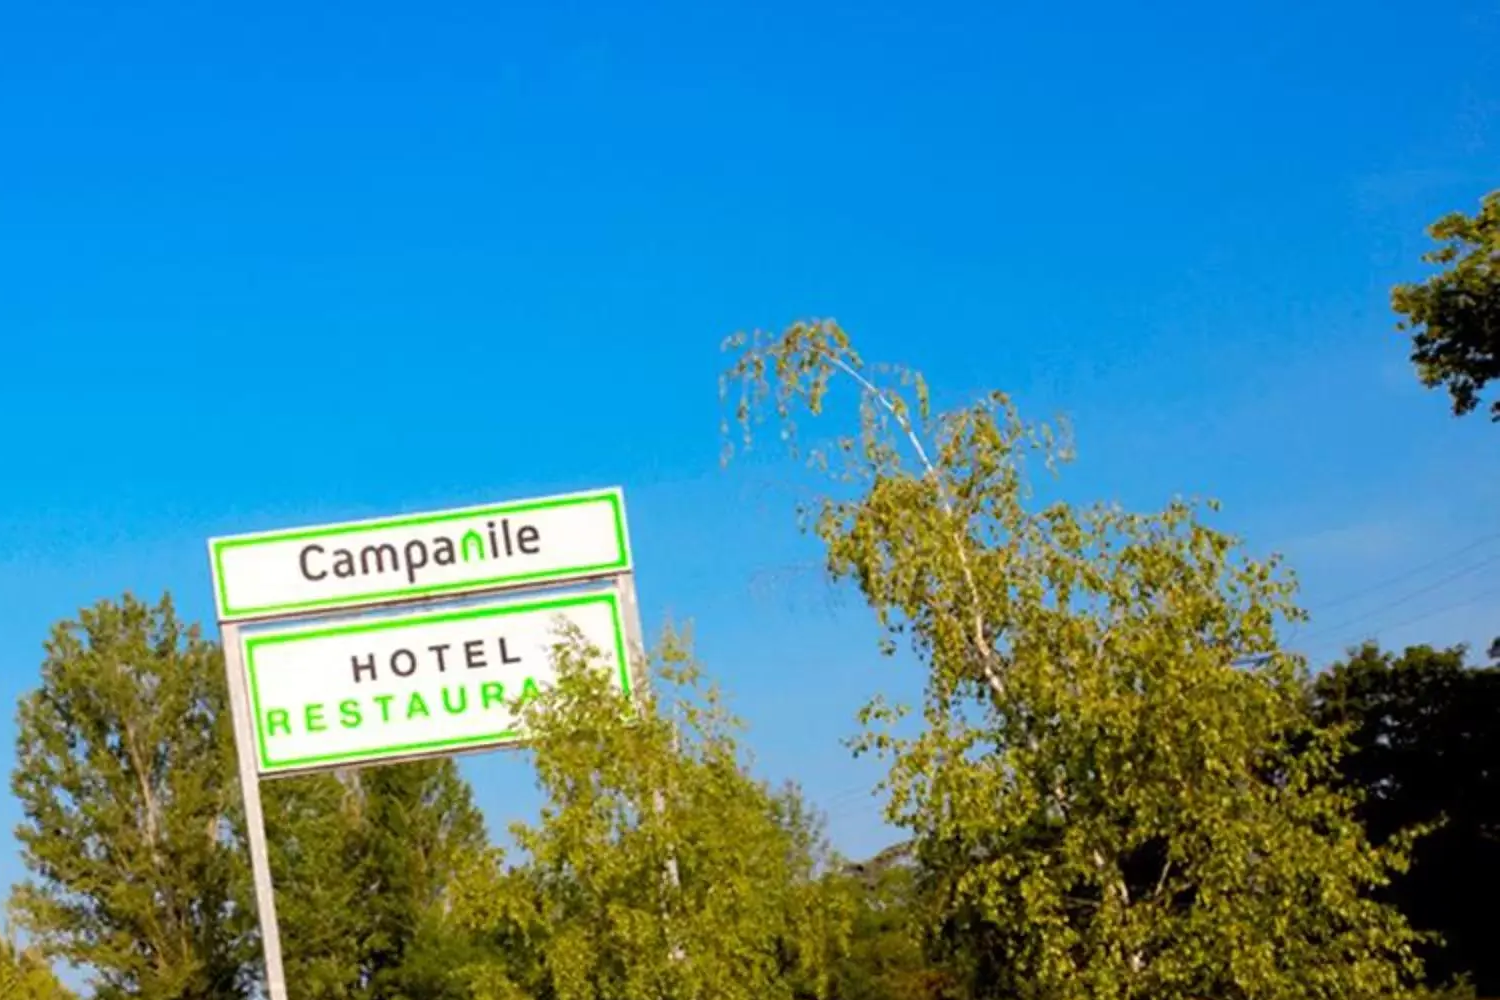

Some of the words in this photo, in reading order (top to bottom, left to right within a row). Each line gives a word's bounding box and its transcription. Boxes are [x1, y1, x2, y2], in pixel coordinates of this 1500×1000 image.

[299, 518, 541, 585] Campanile
[352, 637, 522, 684] HOTEL
[265, 676, 541, 737] RESTAURA
